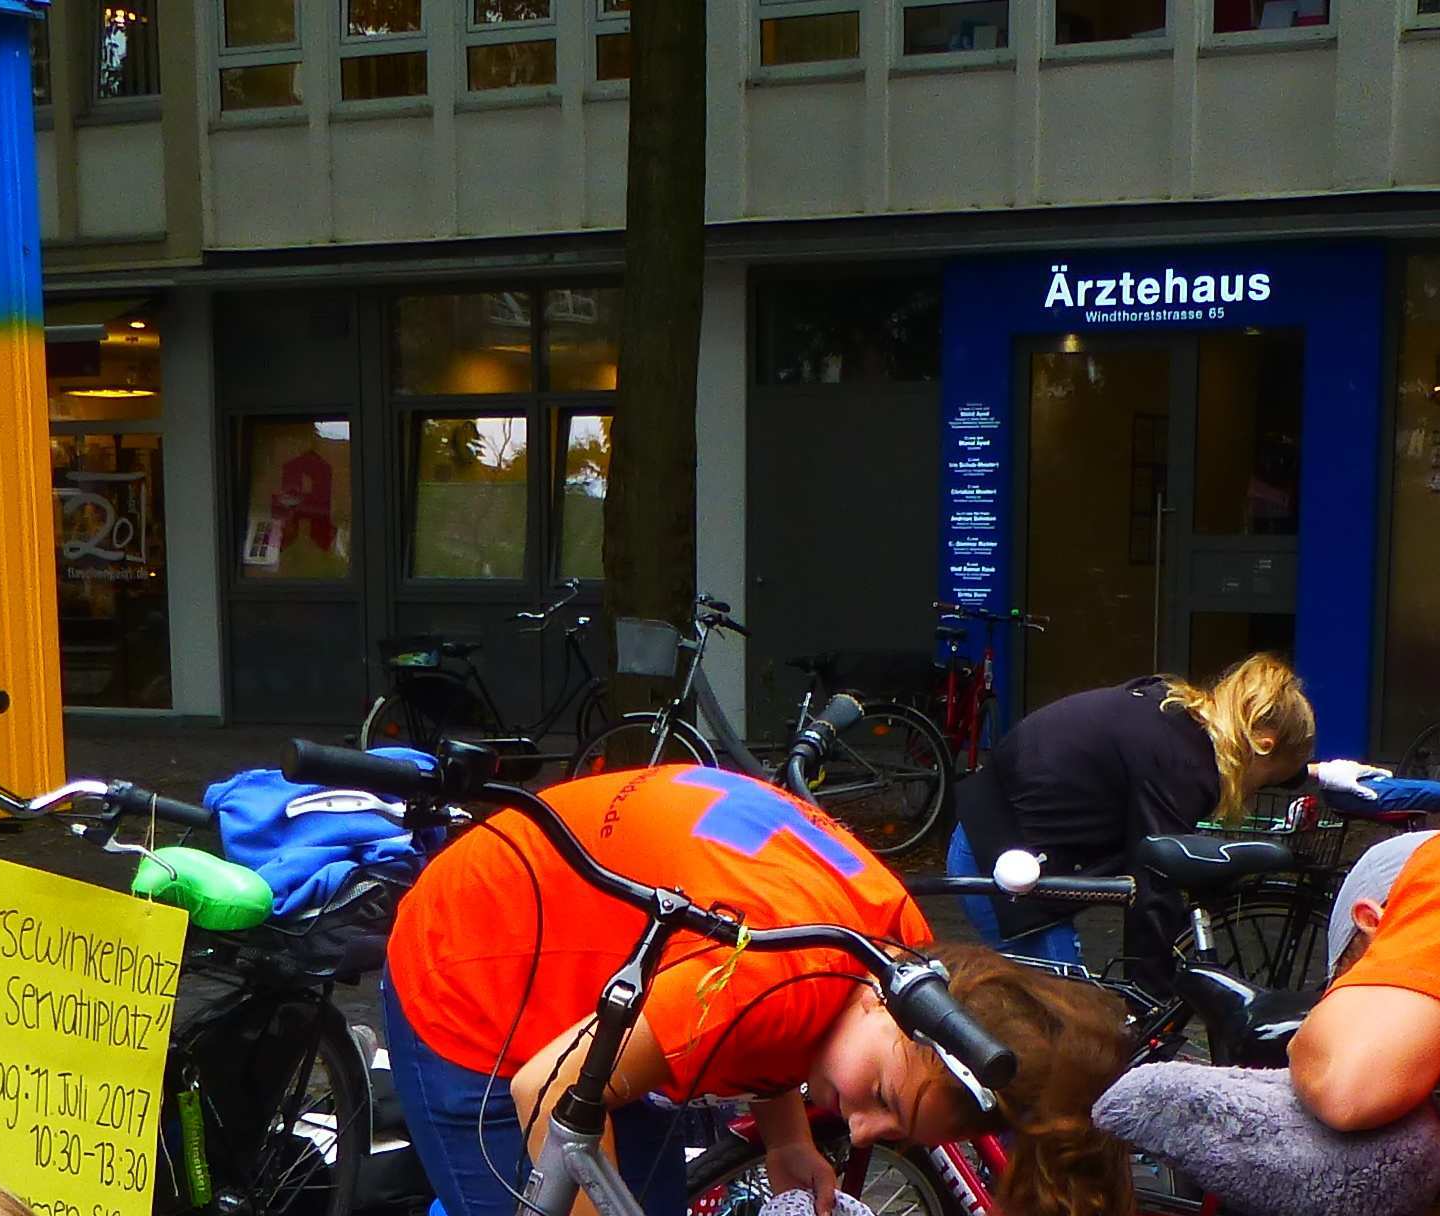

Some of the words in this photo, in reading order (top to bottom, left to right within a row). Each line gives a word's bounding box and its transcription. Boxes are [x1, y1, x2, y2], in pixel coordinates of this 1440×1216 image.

[1044, 264, 1271, 308] Ärztehaus
[1085, 309, 1203, 323] Windthorststrasse
[58, 1072, 89, 1122] Juli
[96, 1083, 151, 1137] 2017
